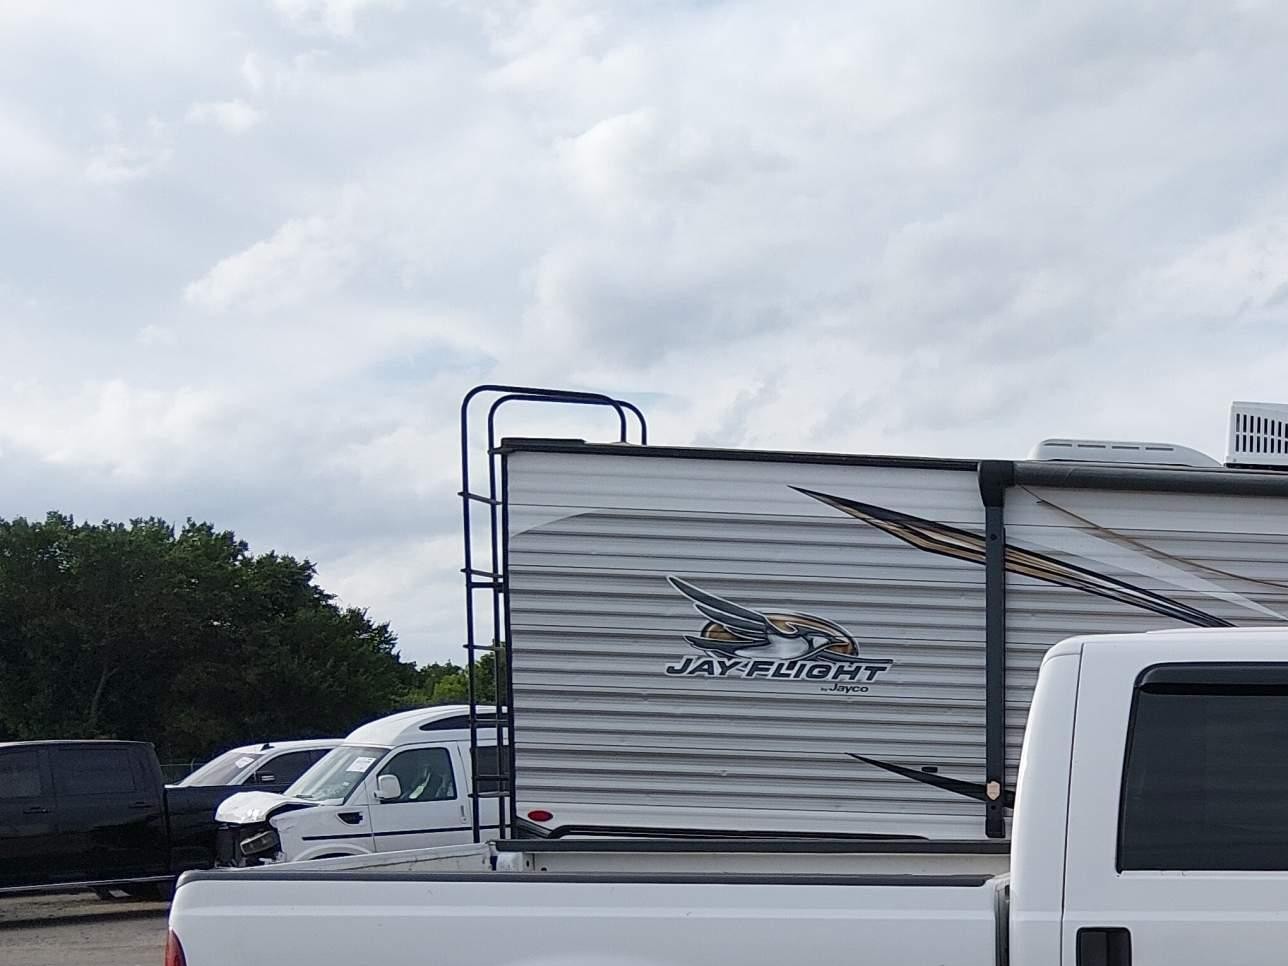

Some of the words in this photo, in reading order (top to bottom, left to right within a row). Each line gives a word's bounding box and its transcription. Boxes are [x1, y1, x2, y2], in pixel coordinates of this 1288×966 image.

[666, 658, 742, 676] JAY
[745, 660, 888, 681] FLIGHT
[829, 683, 869, 693] Jayco
